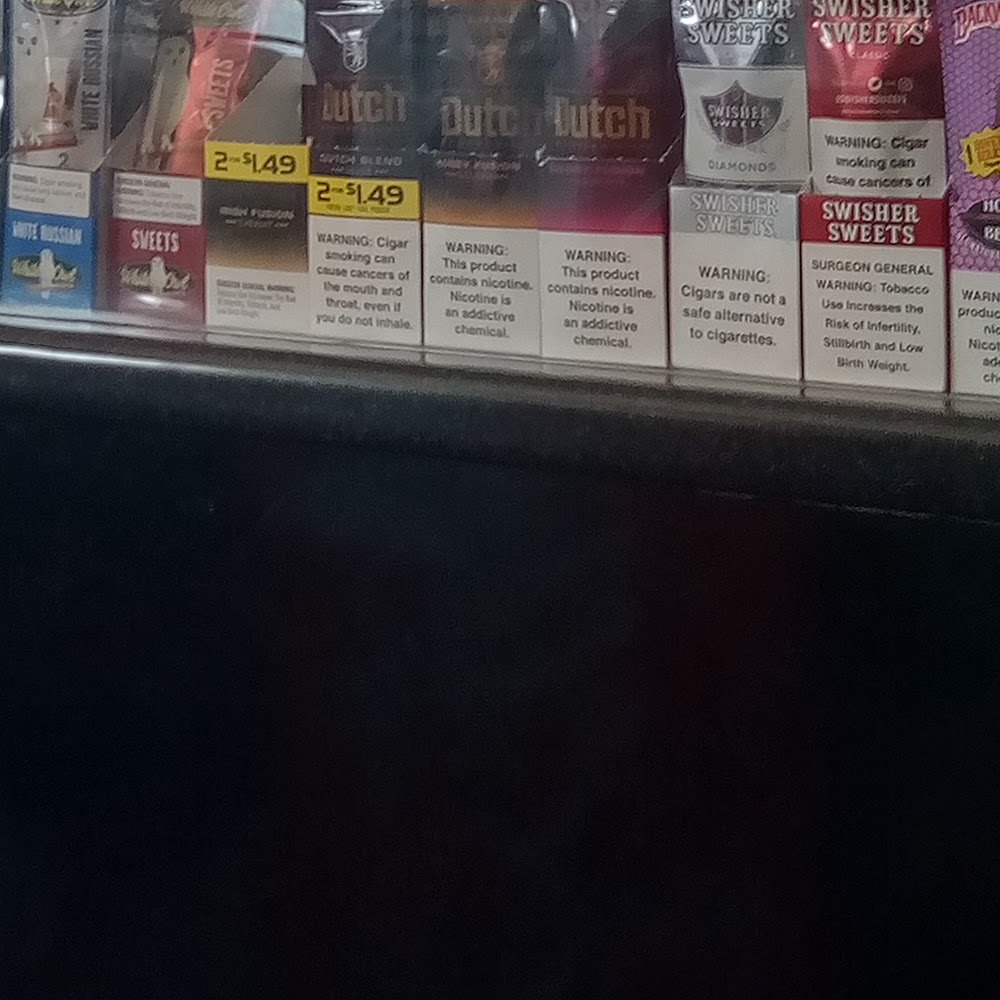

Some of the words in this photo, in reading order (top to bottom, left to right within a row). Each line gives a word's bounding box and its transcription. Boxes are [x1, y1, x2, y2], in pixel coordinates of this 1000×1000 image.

[683, 21, 791, 46] SWEETS
[820, 21, 926, 46] SWEETS
[825, 135, 887, 149] WARNING:
[890, 136, 929, 151] Cigar
[214, 151, 228, 172] 2
[242, 152, 296, 175] $1.49
[889, 158, 915, 168] can
[859, 177, 913, 188] cancers
[916, 175, 931, 187] of
[317, 181, 331, 202] 2
[346, 183, 404, 206] $1.49
[691, 192, 778, 214] SWISHER
[822, 200, 920, 223] SWISHER
[696, 214, 774, 236] SWEETS
[828, 222, 916, 245] SWEETS
[131, 227, 180, 252] SWEETS
[317, 232, 373, 247] WARNING:
[376, 237, 409, 250] Cigar
[445, 241, 509, 256] WARNING:
[565, 248, 631, 264] WARNING:
[325, 251, 371, 265] smoking
[374, 255, 395, 264] can
[442, 257, 467, 272] This
[470, 261, 517, 274] product
[317, 267, 347, 277] cause
[350, 270, 394, 280] cancers
[398, 270, 410, 280] of
[562, 265, 587, 278] This
[591, 269, 640, 282] product
[699, 265, 771, 284] WARNING:
[811, 259, 871, 274] SURGEON
[874, 263, 934, 276] GENERAL
[323, 281, 341, 292] the
[343, 284, 378, 295] mouth
[382, 286, 403, 297] and
[429, 274, 478, 287] contains
[481, 278, 533, 291] nicotine.
[547, 283, 598, 296] contains
[601, 286, 656, 299] nicotine.
[816, 279, 876, 293] WARNING:
[880, 282, 930, 296] Tobacco
[450, 291, 498, 304] Nicotine
[501, 294, 511, 305] is
[681, 284, 725, 302] Cigars
[728, 291, 751, 304] are
[754, 292, 776, 305] not
[777, 296, 786, 306] a
[325, 297, 361, 309] throat,
[363, 301, 391, 312] even
[393, 301, 401, 312] if
[569, 300, 620, 314] Nicotine
[623, 303, 634, 315] is
[822, 298, 843, 310] Use
[846, 301, 902, 313] Increases
[905, 303, 924, 316] the
[316, 314, 335, 325] you
[338, 313, 352, 324] do
[355, 316, 373, 327] not
[376, 318, 413, 330] inhale.
[445, 308, 459, 318] an
[462, 307, 516, 322] addictive
[682, 306, 711, 320] safe
[714, 309, 786, 327] alternative
[454, 324, 510, 338] chemical.
[563, 318, 579, 328] an
[582, 317, 638, 332] addictive
[825, 318, 850, 330] Risk
[852, 320, 865, 331] of
[573, 334, 632, 349] chemical.
[690, 327, 703, 340] to
[707, 329, 777, 348] cigarettes.
[823, 336, 872, 350] Stillbirth
[874, 341, 896, 352] and
[899, 342, 924, 354] Low
[837, 356, 864, 369] Birth
[867, 359, 910, 373] Weight.
